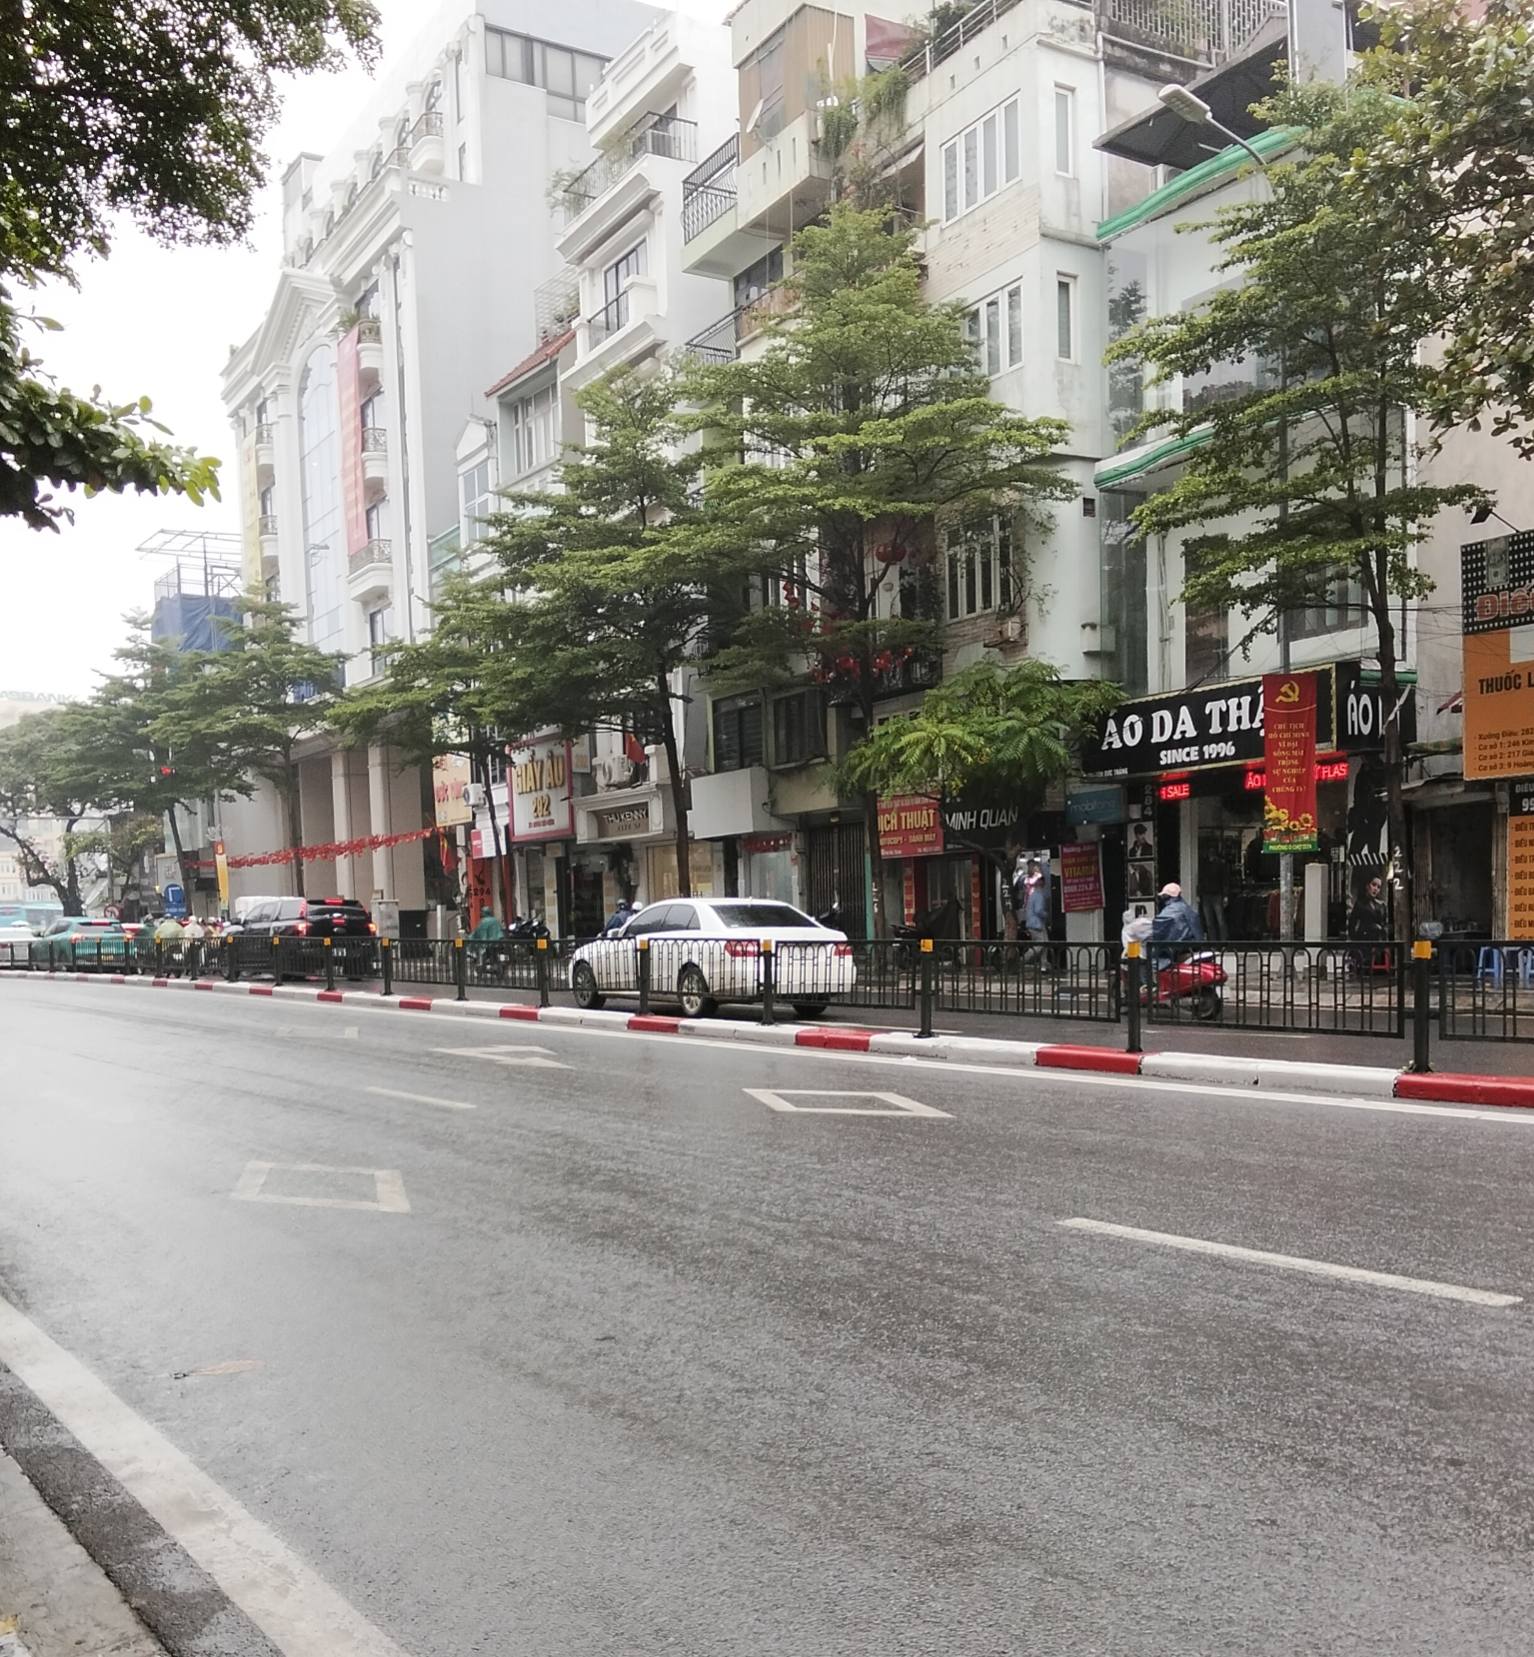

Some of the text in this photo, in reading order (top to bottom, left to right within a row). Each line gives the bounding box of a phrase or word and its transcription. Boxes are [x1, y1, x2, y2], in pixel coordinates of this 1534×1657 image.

[1478, 669, 1522, 695] THUỐC
[1347, 680, 1373, 736] ÁO
[1101, 710, 1143, 750] ÁO
[1150, 705, 1198, 744] DA
[1159, 741, 1236, 765] SINCE 1996
[1167, 783, 1190, 798] SALE
[900, 806, 935, 831] THUẬT
